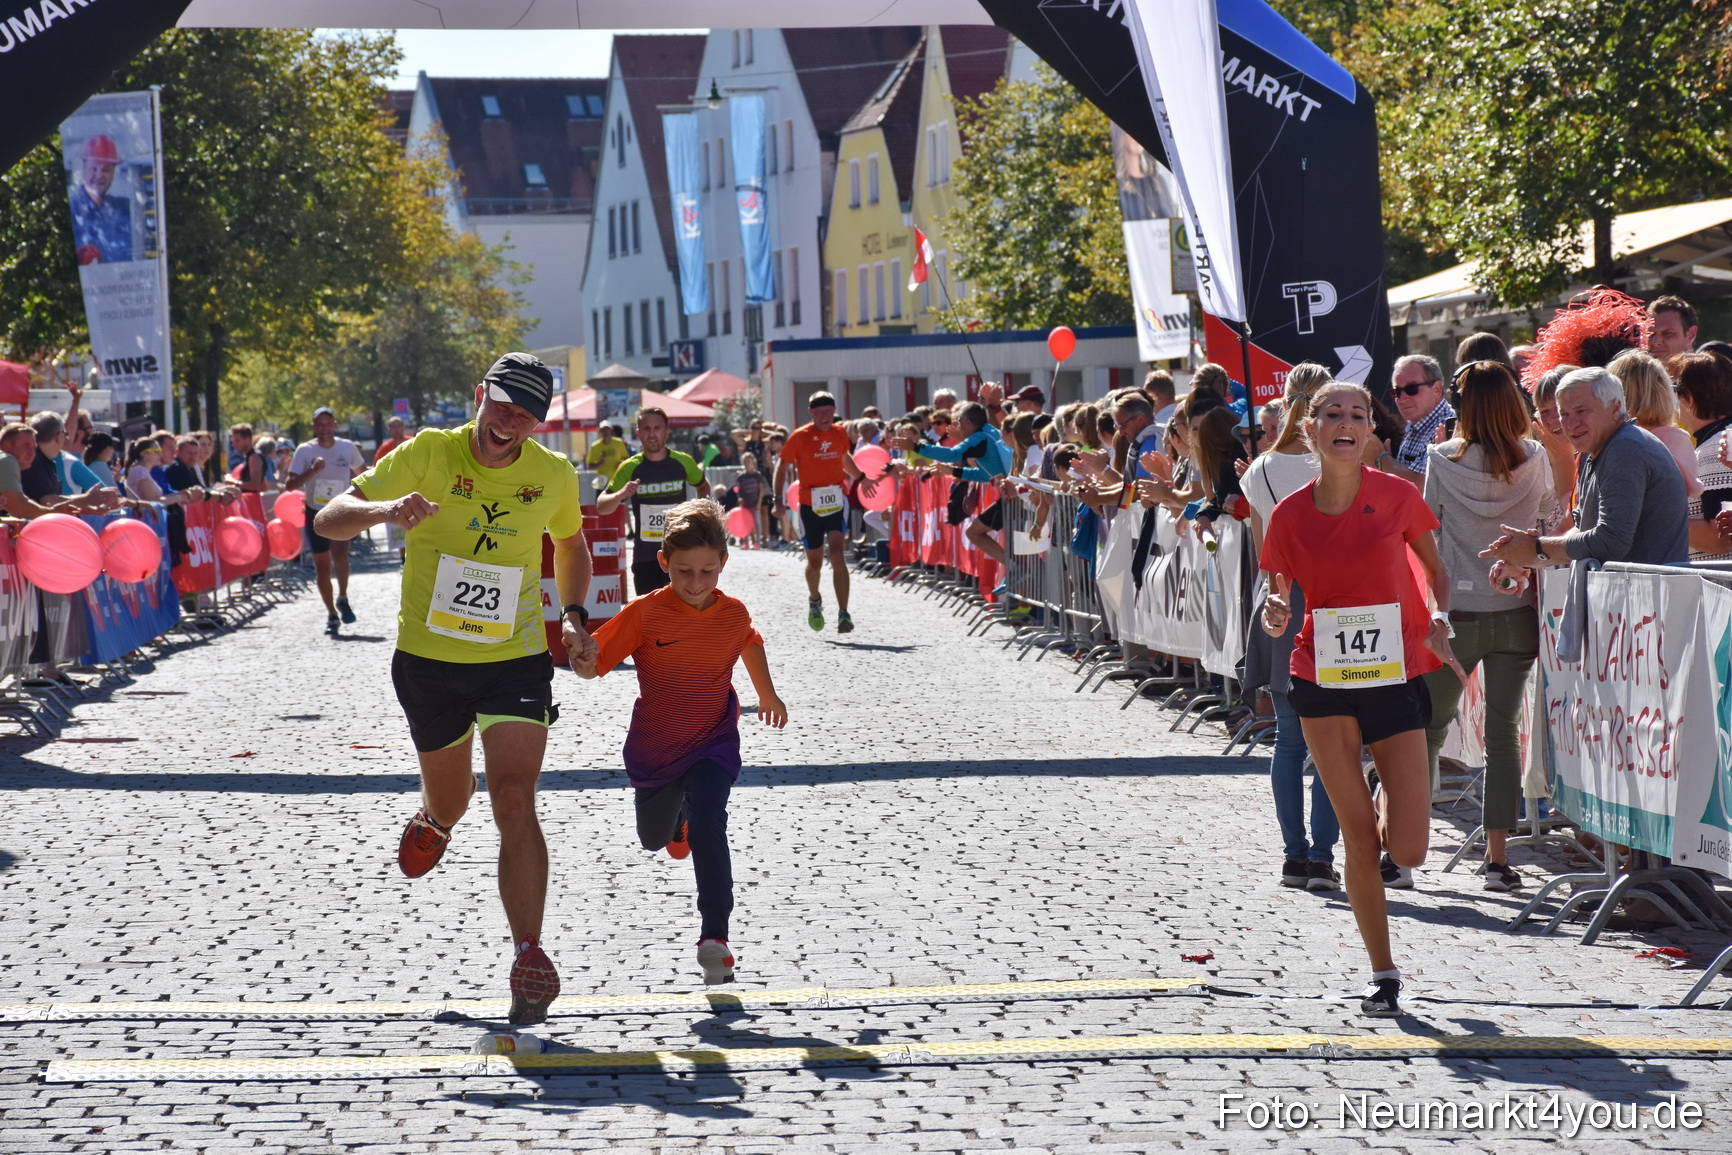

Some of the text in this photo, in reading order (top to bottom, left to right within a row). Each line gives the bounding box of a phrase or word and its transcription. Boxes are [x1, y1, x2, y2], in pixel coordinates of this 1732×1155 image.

[1255, 386, 1275, 396] 100
[453, 474, 474, 493] 15
[637, 480, 684, 495] BOCK
[451, 487, 472, 499] 2015
[820, 494, 836, 505] 100
[463, 566, 502, 581] BOCK
[452, 581, 501, 611] 223
[448, 605, 493, 620] PARTL Neumarkt
[1338, 613, 1376, 625] BOCK
[458, 620, 484, 634] Jens
[1334, 628, 1381, 655] 147
[1341, 669, 1381, 680] Simone
[1697, 834, 1716, 856] Jura
